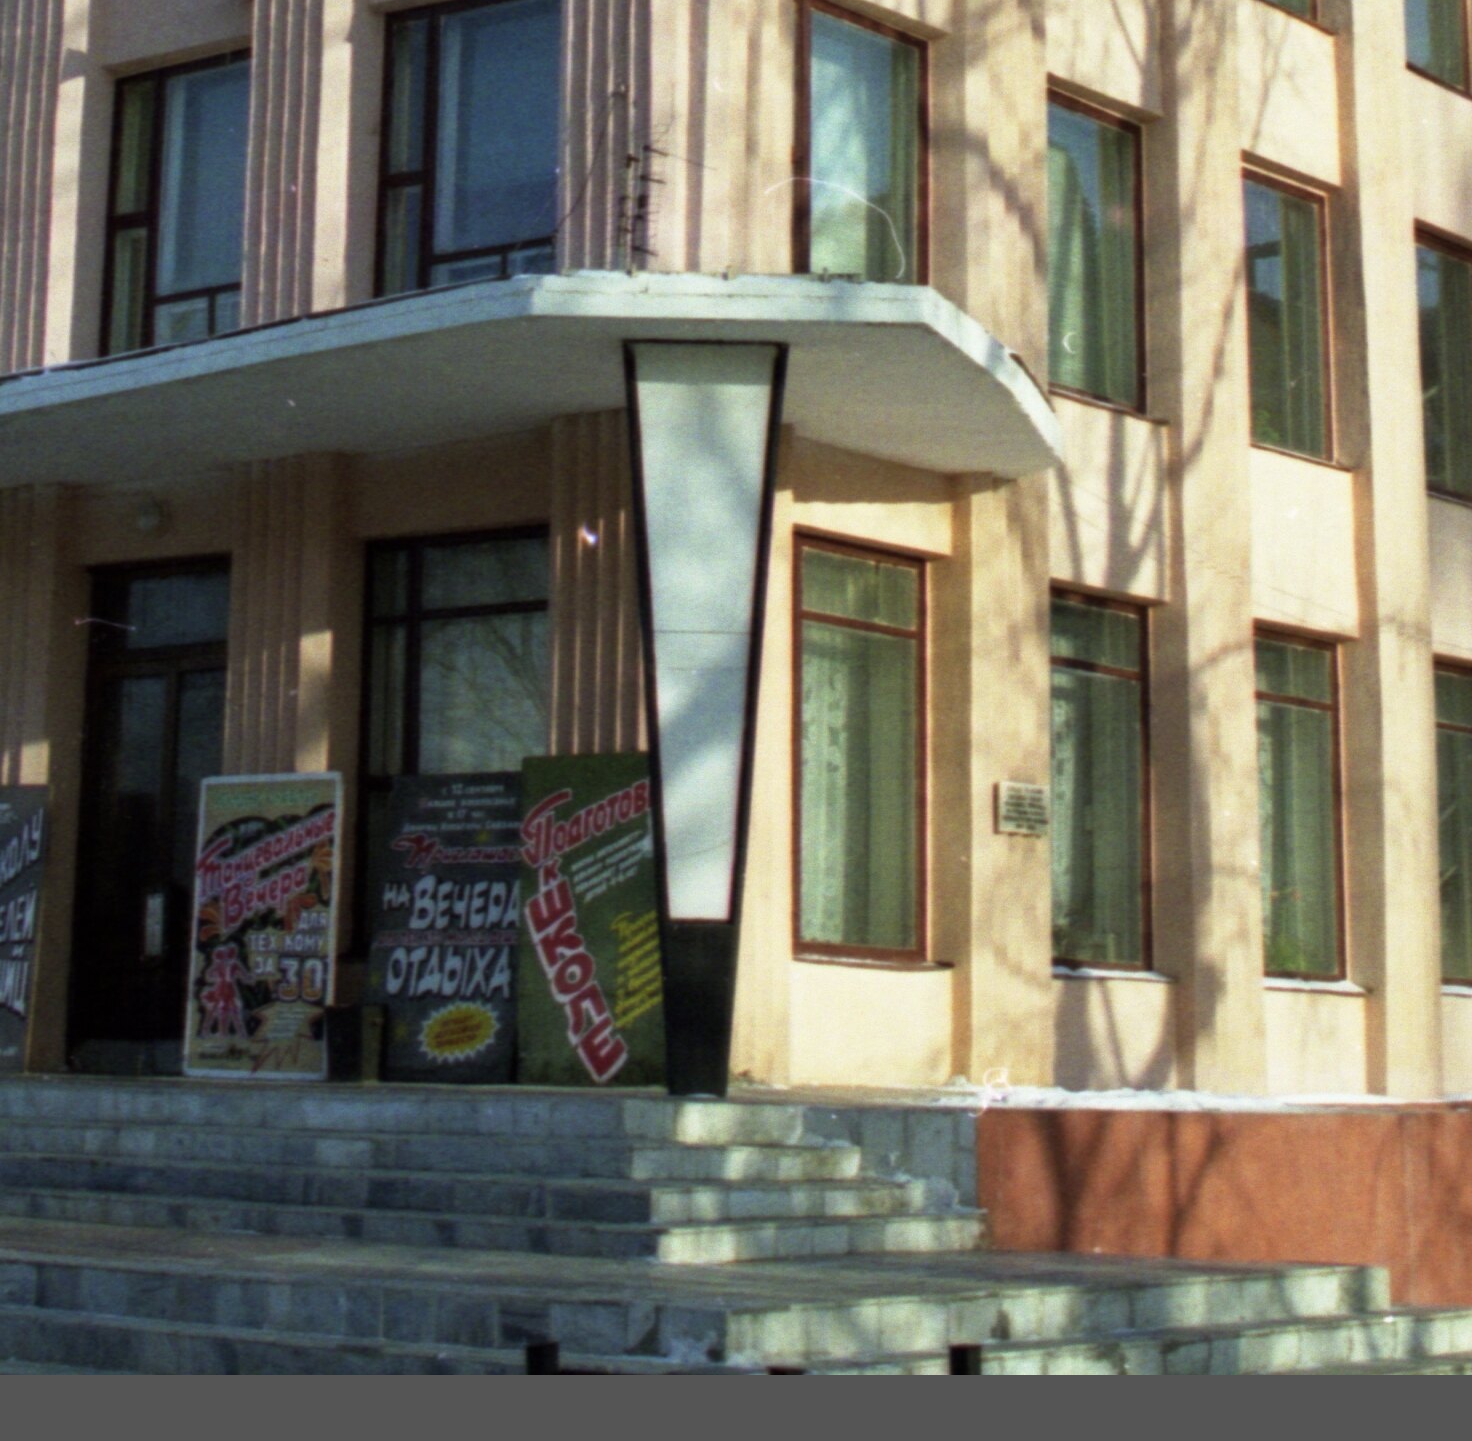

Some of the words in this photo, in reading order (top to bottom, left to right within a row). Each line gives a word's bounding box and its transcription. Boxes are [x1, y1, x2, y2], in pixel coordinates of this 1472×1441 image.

[221, 862, 310, 933] Вечера
[409, 875, 521, 930] ВЕЧЕРА
[385, 946, 512, 1000] ОТДЫХА
[526, 878, 628, 1082] ШКОЛЕ
